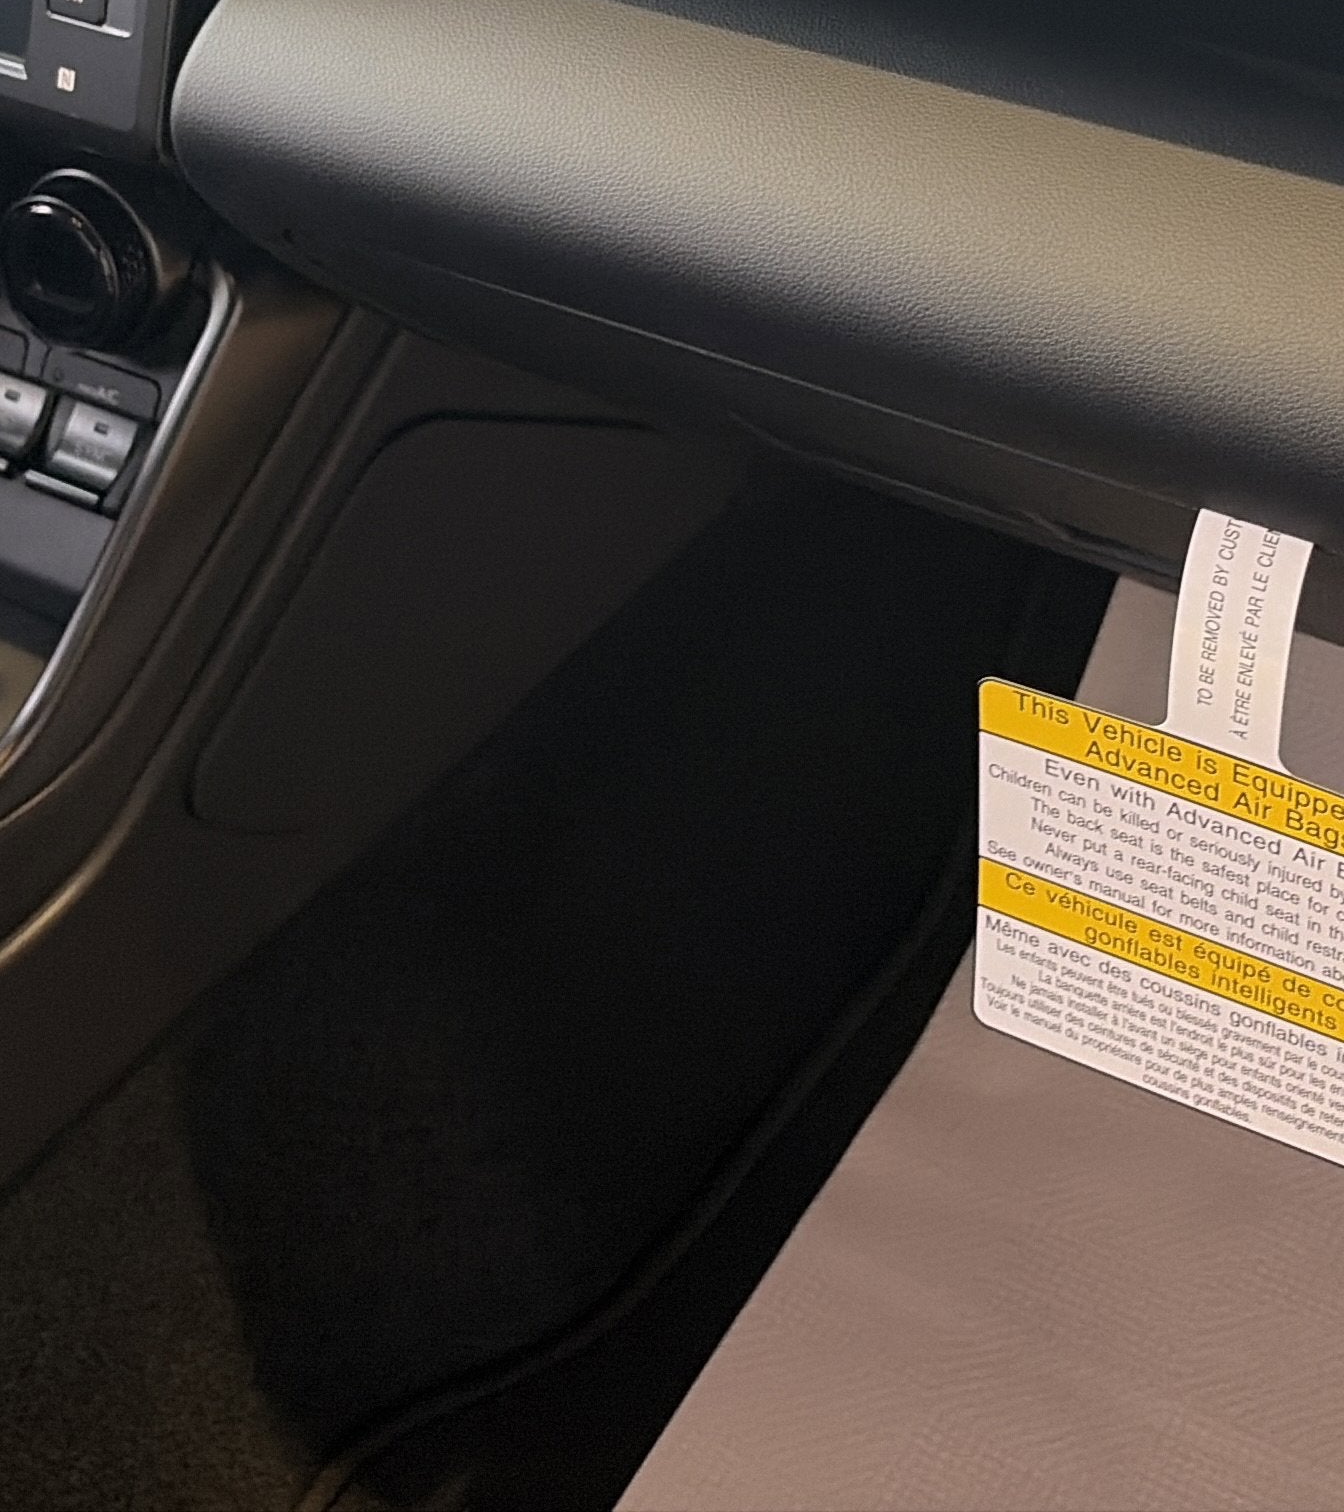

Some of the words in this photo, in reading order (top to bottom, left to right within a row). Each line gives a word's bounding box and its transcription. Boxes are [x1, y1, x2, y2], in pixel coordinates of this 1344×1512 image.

[1214, 565, 1230, 587] BY
[1244, 595, 1266, 629] PAR
[1252, 571, 1271, 594] LE
[1202, 590, 1226, 663] REMOVED
[1238, 631, 1258, 687] ENLEVÉ
[1197, 688, 1213, 707] TO
[1199, 664, 1215, 685] BE
[1231, 691, 1252, 726] ÊTRE
[1012, 689, 1070, 726] This
[1081, 711, 1183, 763] Vehicle
[1195, 749, 1218, 776] is
[1044, 757, 1101, 792] Even
[1109, 783, 1156, 812] with
[1165, 801, 1283, 857] Advanced
[1291, 846, 1328, 872] Air
[1083, 739, 1221, 803] Advanced
[1231, 790, 1273, 821] Air
[987, 762, 1053, 798] Children
[1057, 789, 1087, 810] can
[1092, 797, 1114, 819] be
[1119, 807, 1161, 835] killed
[1165, 827, 1185, 843] or
[1188, 835, 1262, 874] seriously
[1266, 859, 1324, 894] injured
[1029, 795, 1061, 820] The
[1066, 808, 1105, 836] back
[1109, 827, 1145, 850] seat
[1149, 841, 1165, 857] is
[1169, 846, 1196, 868] the
[1201, 860, 1251, 889] safest
[1255, 880, 1302, 906] place
[1306, 894, 1331, 917] for
[986, 839, 1018, 863] See
[1022, 855, 1084, 887] owner's
[1088, 879, 1146, 910] manual
[1150, 899, 1174, 919] for
[1178, 912, 1221, 937] more
[1225, 925, 1317, 973] information
[1030, 815, 1079, 845] Never
[1081, 837, 1109, 857] put
[1112, 848, 1125, 863] a
[1129, 854, 1216, 899] rear-facing
[1220, 887, 1260, 912] child
[1264, 903, 1301, 927] seat
[1306, 915, 1323, 935] in
[1043, 841, 1100, 874] Always
[1104, 865, 1135, 886] use
[1139, 878, 1175, 901] seat
[1179, 889, 1219, 917] belts
[1223, 908, 1256, 931] and
[1260, 922, 1300, 947] child
[1004, 871, 1037, 897] Ce
[1045, 888, 1139, 935] véhicule
[1147, 928, 1184, 953] est
[1192, 941, 1272, 984] équipé
[1281, 975, 1312, 999] de
[1083, 925, 1201, 980] gonflables
[1210, 968, 1338, 1031] intelligents
[984, 913, 1041, 949] Même
[1046, 941, 1092, 969] avec
[1097, 959, 1133, 984] des
[1138, 976, 1222, 1018] coussins
[1228, 1010, 1329, 1058] gonflables
